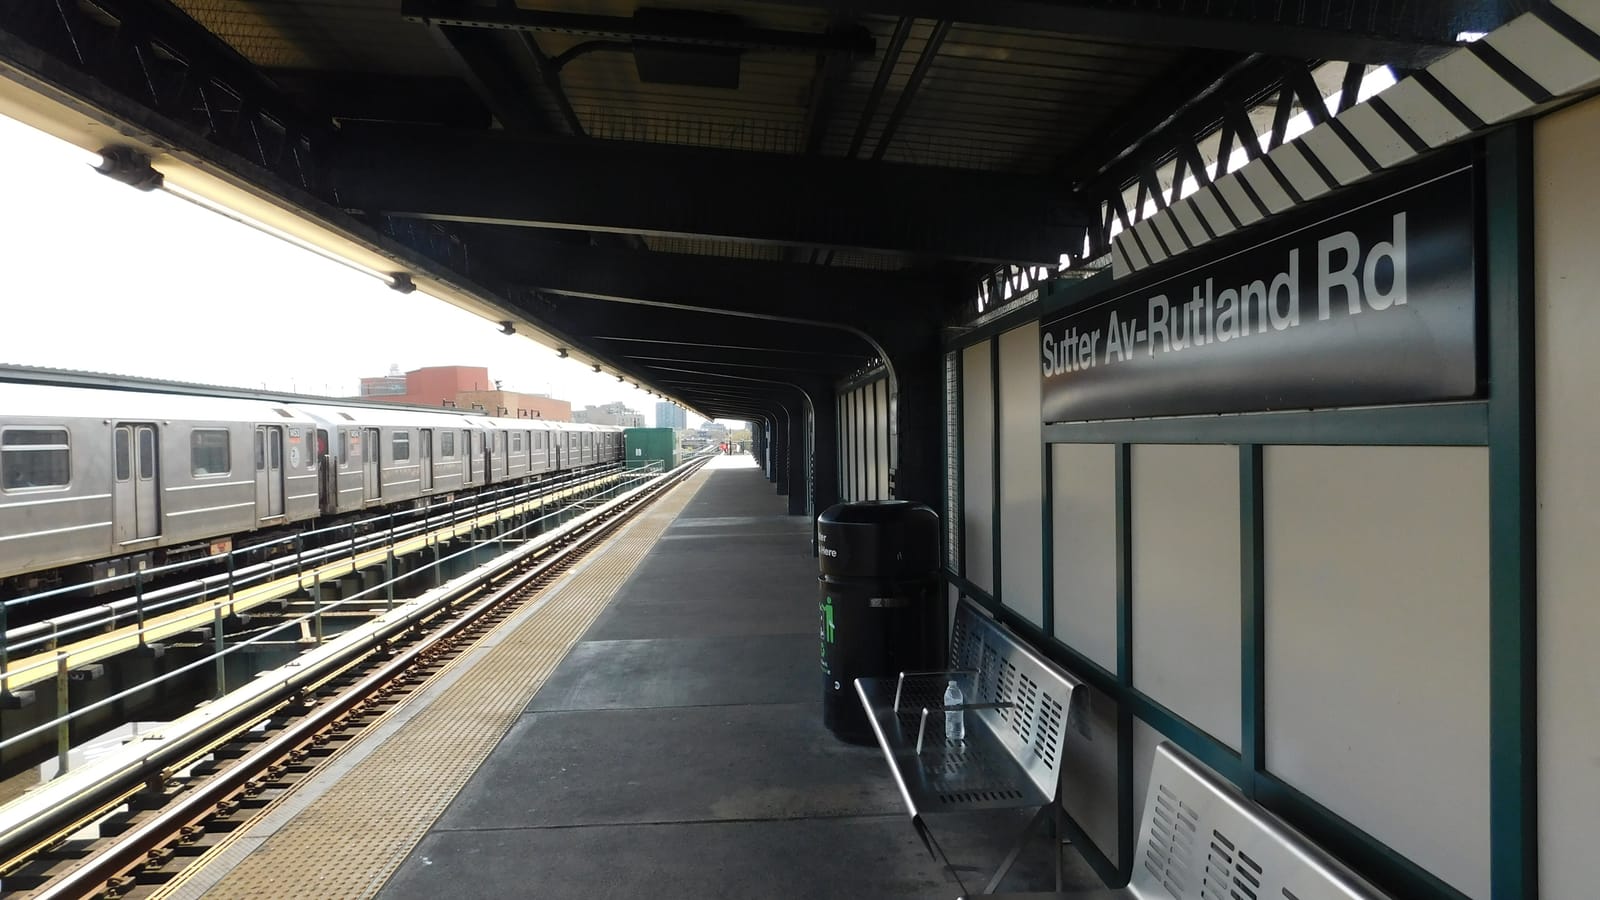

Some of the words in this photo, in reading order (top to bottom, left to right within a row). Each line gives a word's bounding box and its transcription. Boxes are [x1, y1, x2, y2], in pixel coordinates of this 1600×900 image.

[1042, 328, 1099, 377] Sutter
[1104, 248, 1300, 365] Av-Rutland
[1317, 211, 1407, 321] Rd
